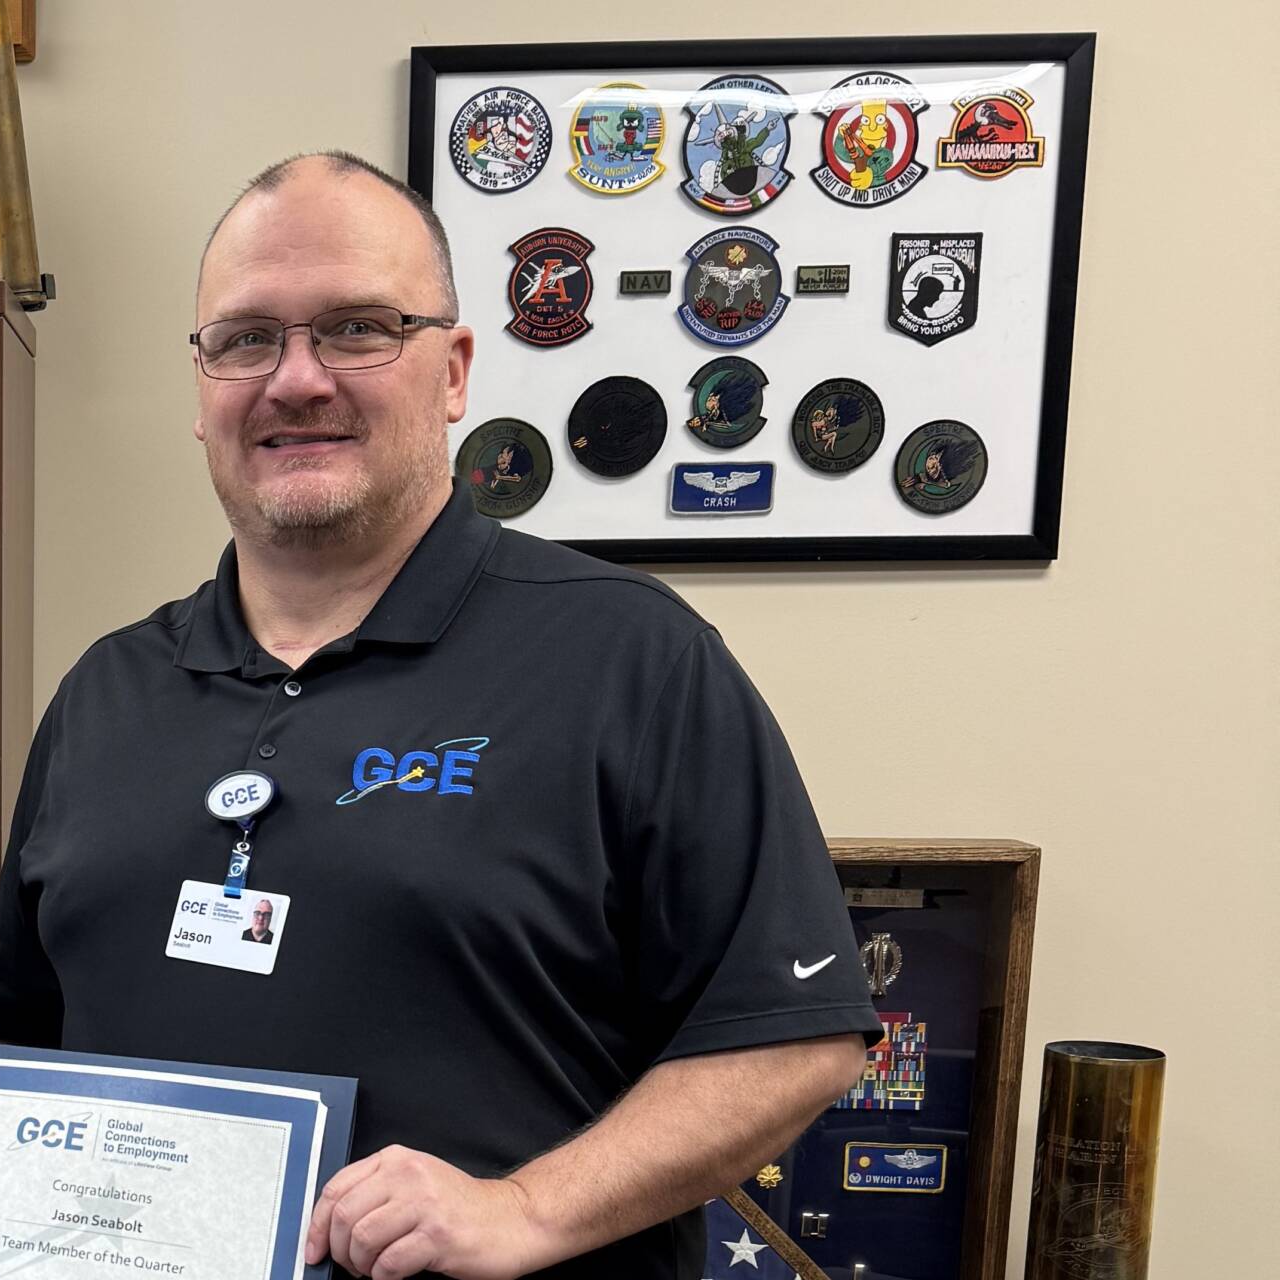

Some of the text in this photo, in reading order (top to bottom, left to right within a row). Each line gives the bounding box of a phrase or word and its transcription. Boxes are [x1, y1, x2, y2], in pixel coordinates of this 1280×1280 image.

[727, 81, 754, 89] OTHER
[456, 101, 479, 131] MATHER
[507, 92, 530, 106] FORCE
[531, 106, 546, 127] BASE
[480, 167, 533, 187] 1918 1993
[577, 167, 625, 188] SUNT
[818, 167, 918, 202] SHUT UP AND DRIVE MAN!
[521, 237, 586, 255] AUBURN UNIVERSITY
[694, 231, 773, 257] AIR FORCE NAVIGATORS
[898, 249, 907, 272] OF
[909, 248, 929, 262] WOOD
[947, 249, 975, 273] ACADEMIA
[627, 275, 664, 289] NAV
[749, 327, 762, 337] FOR
[761, 315, 774, 329] THE
[772, 300, 784, 315] MAN
[898, 316, 918, 332] BRING
[942, 321, 958, 332] OPS
[518, 320, 580, 338] AIR FORCE ROTC
[704, 498, 736, 507] CRASH
[352, 747, 480, 795] GCE
[222, 784, 260, 808] GCE
[181, 900, 208, 916] GCE
[174, 928, 212, 944] Jason
[17, 1117, 87, 1151] GCE
[108, 1119, 143, 1133] Global
[105, 1130, 176, 1149] Connections
[104, 1143, 188, 1163] to Employment
[865, 1175, 935, 1185] DWIGHT DAVIS
[53, 1179, 152, 1204] Congratulations
[52, 1209, 143, 1233] Jason Seabolt
[1, 1235, 184, 1274] Team Member of the Quarter
